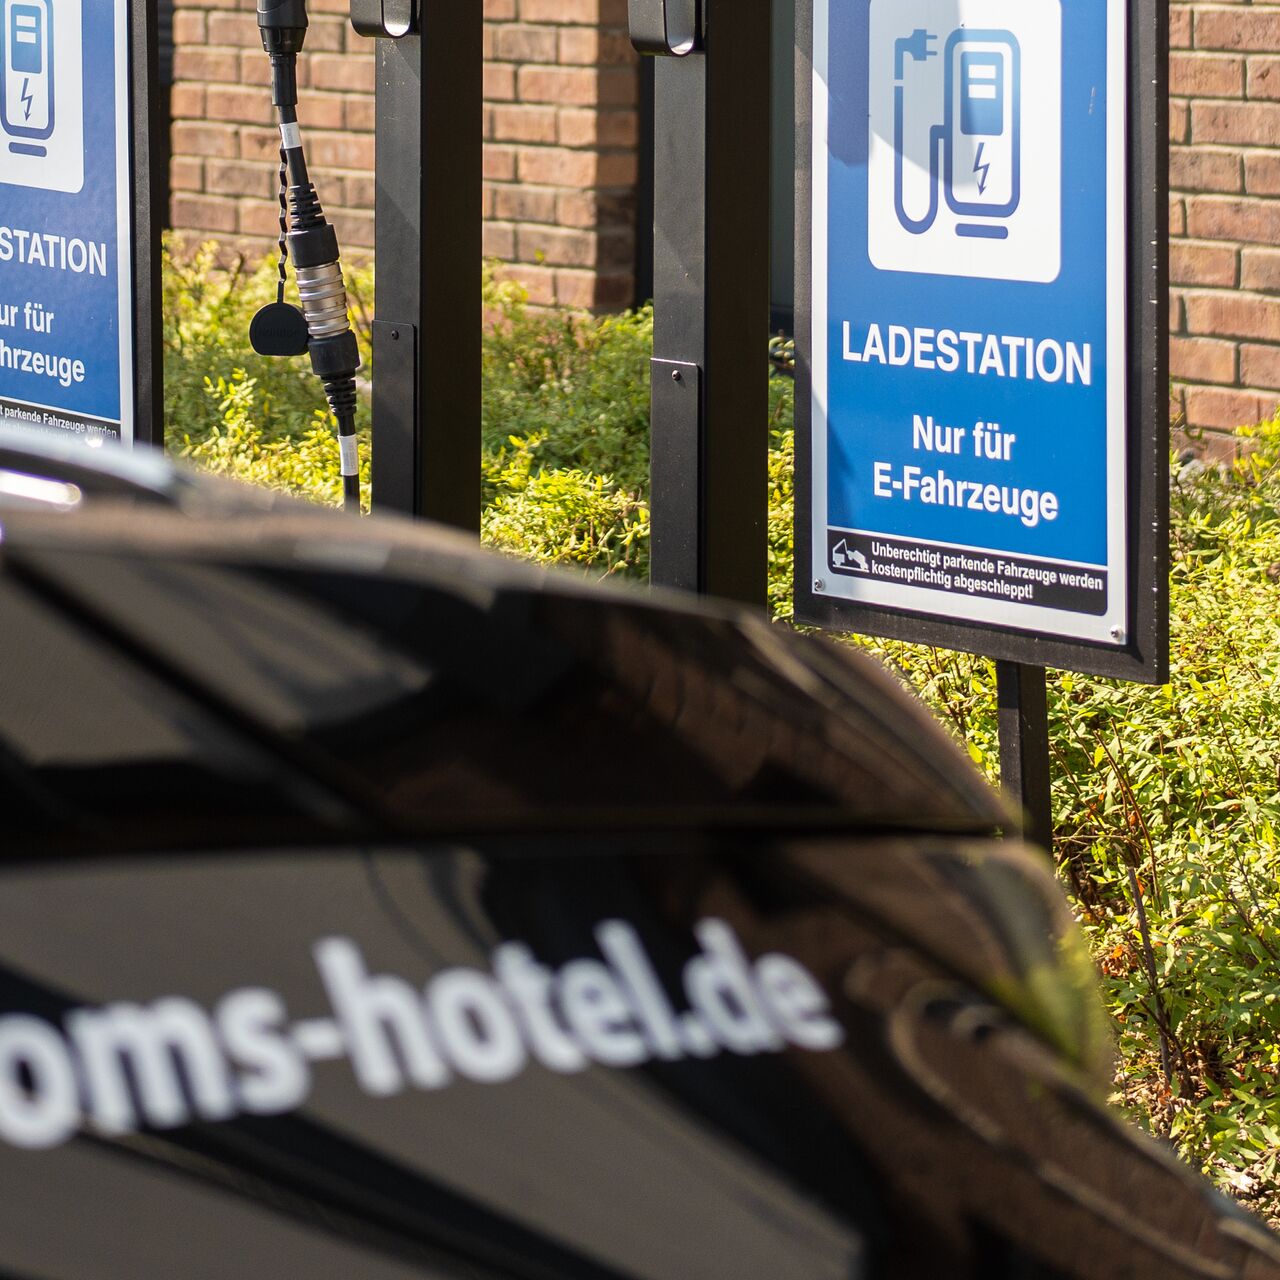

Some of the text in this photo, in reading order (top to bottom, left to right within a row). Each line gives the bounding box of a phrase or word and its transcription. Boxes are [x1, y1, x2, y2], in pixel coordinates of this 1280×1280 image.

[23, 302, 55, 333] für
[842, 320, 1091, 385] LADESTATION
[4, 407, 42, 424] parkende
[43, 413, 85, 433] Fahrzeuge
[86, 424, 117, 439] werden
[912, 414, 1017, 461] Nur für
[873, 461, 1059, 528] E-Fahrzeuge
[871, 541, 1104, 591] Unberechtigt parkende Fahrzeuge werden
[871, 560, 1034, 600] kostenpflichtig abgeschleppt!
